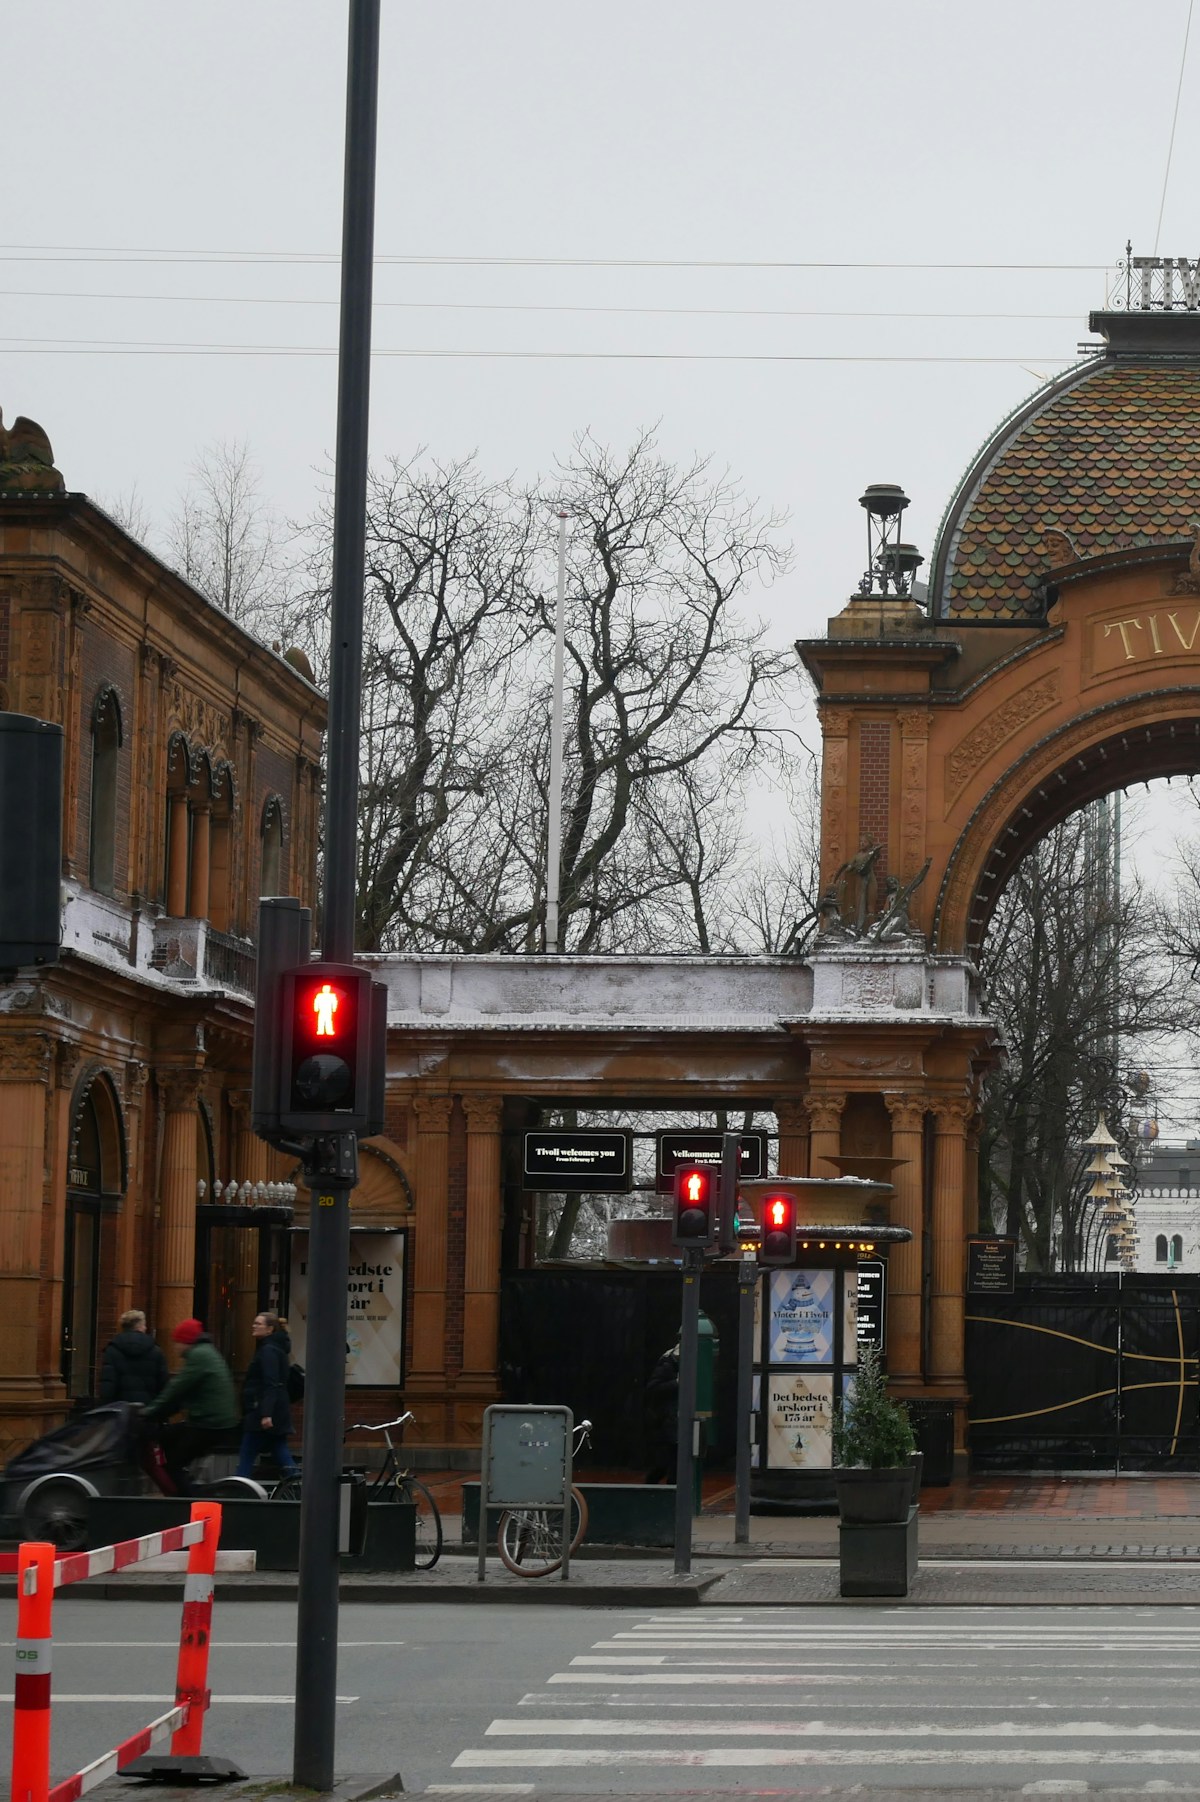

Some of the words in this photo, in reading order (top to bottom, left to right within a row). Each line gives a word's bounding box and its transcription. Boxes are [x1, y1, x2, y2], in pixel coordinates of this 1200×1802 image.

[535, 1148, 559, 1156] Tivoli
[560, 1148, 599, 1156] welcomes
[672, 1150, 719, 1158] Velkommen
[319, 1196, 334, 1206] 20
[347, 1262, 393, 1276] edste
[350, 1295, 370, 1310] år
[773, 1393, 789, 1402] Det
[793, 1393, 828, 1402] bedste
[777, 1403, 816, 1412] årskort
[785, 1413, 800, 1422] 175
[802, 1413, 815, 1422] år
